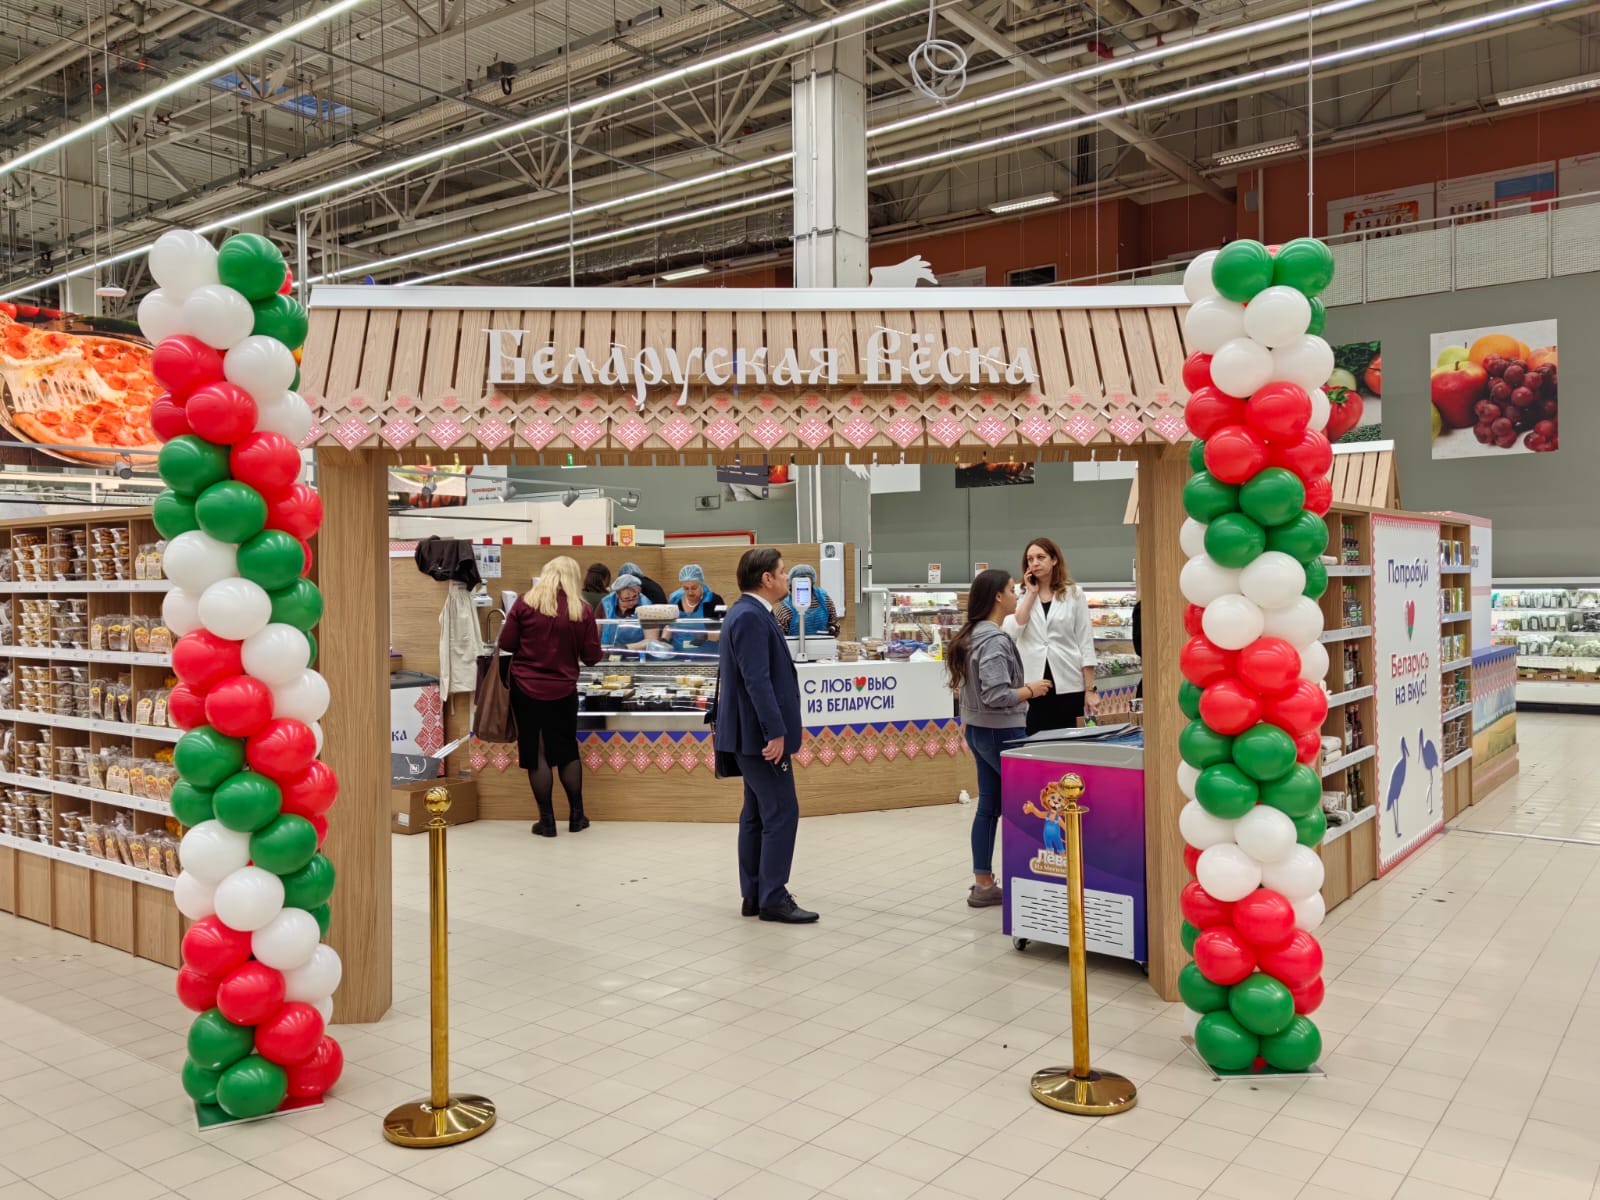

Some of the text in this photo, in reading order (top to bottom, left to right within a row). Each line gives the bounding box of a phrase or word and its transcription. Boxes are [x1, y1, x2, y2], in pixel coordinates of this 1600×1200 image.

[863, 328, 1036, 385] Вёска
[1387, 558, 1429, 588] Попробуй
[1391, 652, 1430, 679] Беларусь
[803, 679, 817, 695] С
[1395, 674, 1428, 706] на вкус!
[807, 695, 895, 714] ИЗ БЕЛАРУСИ!
